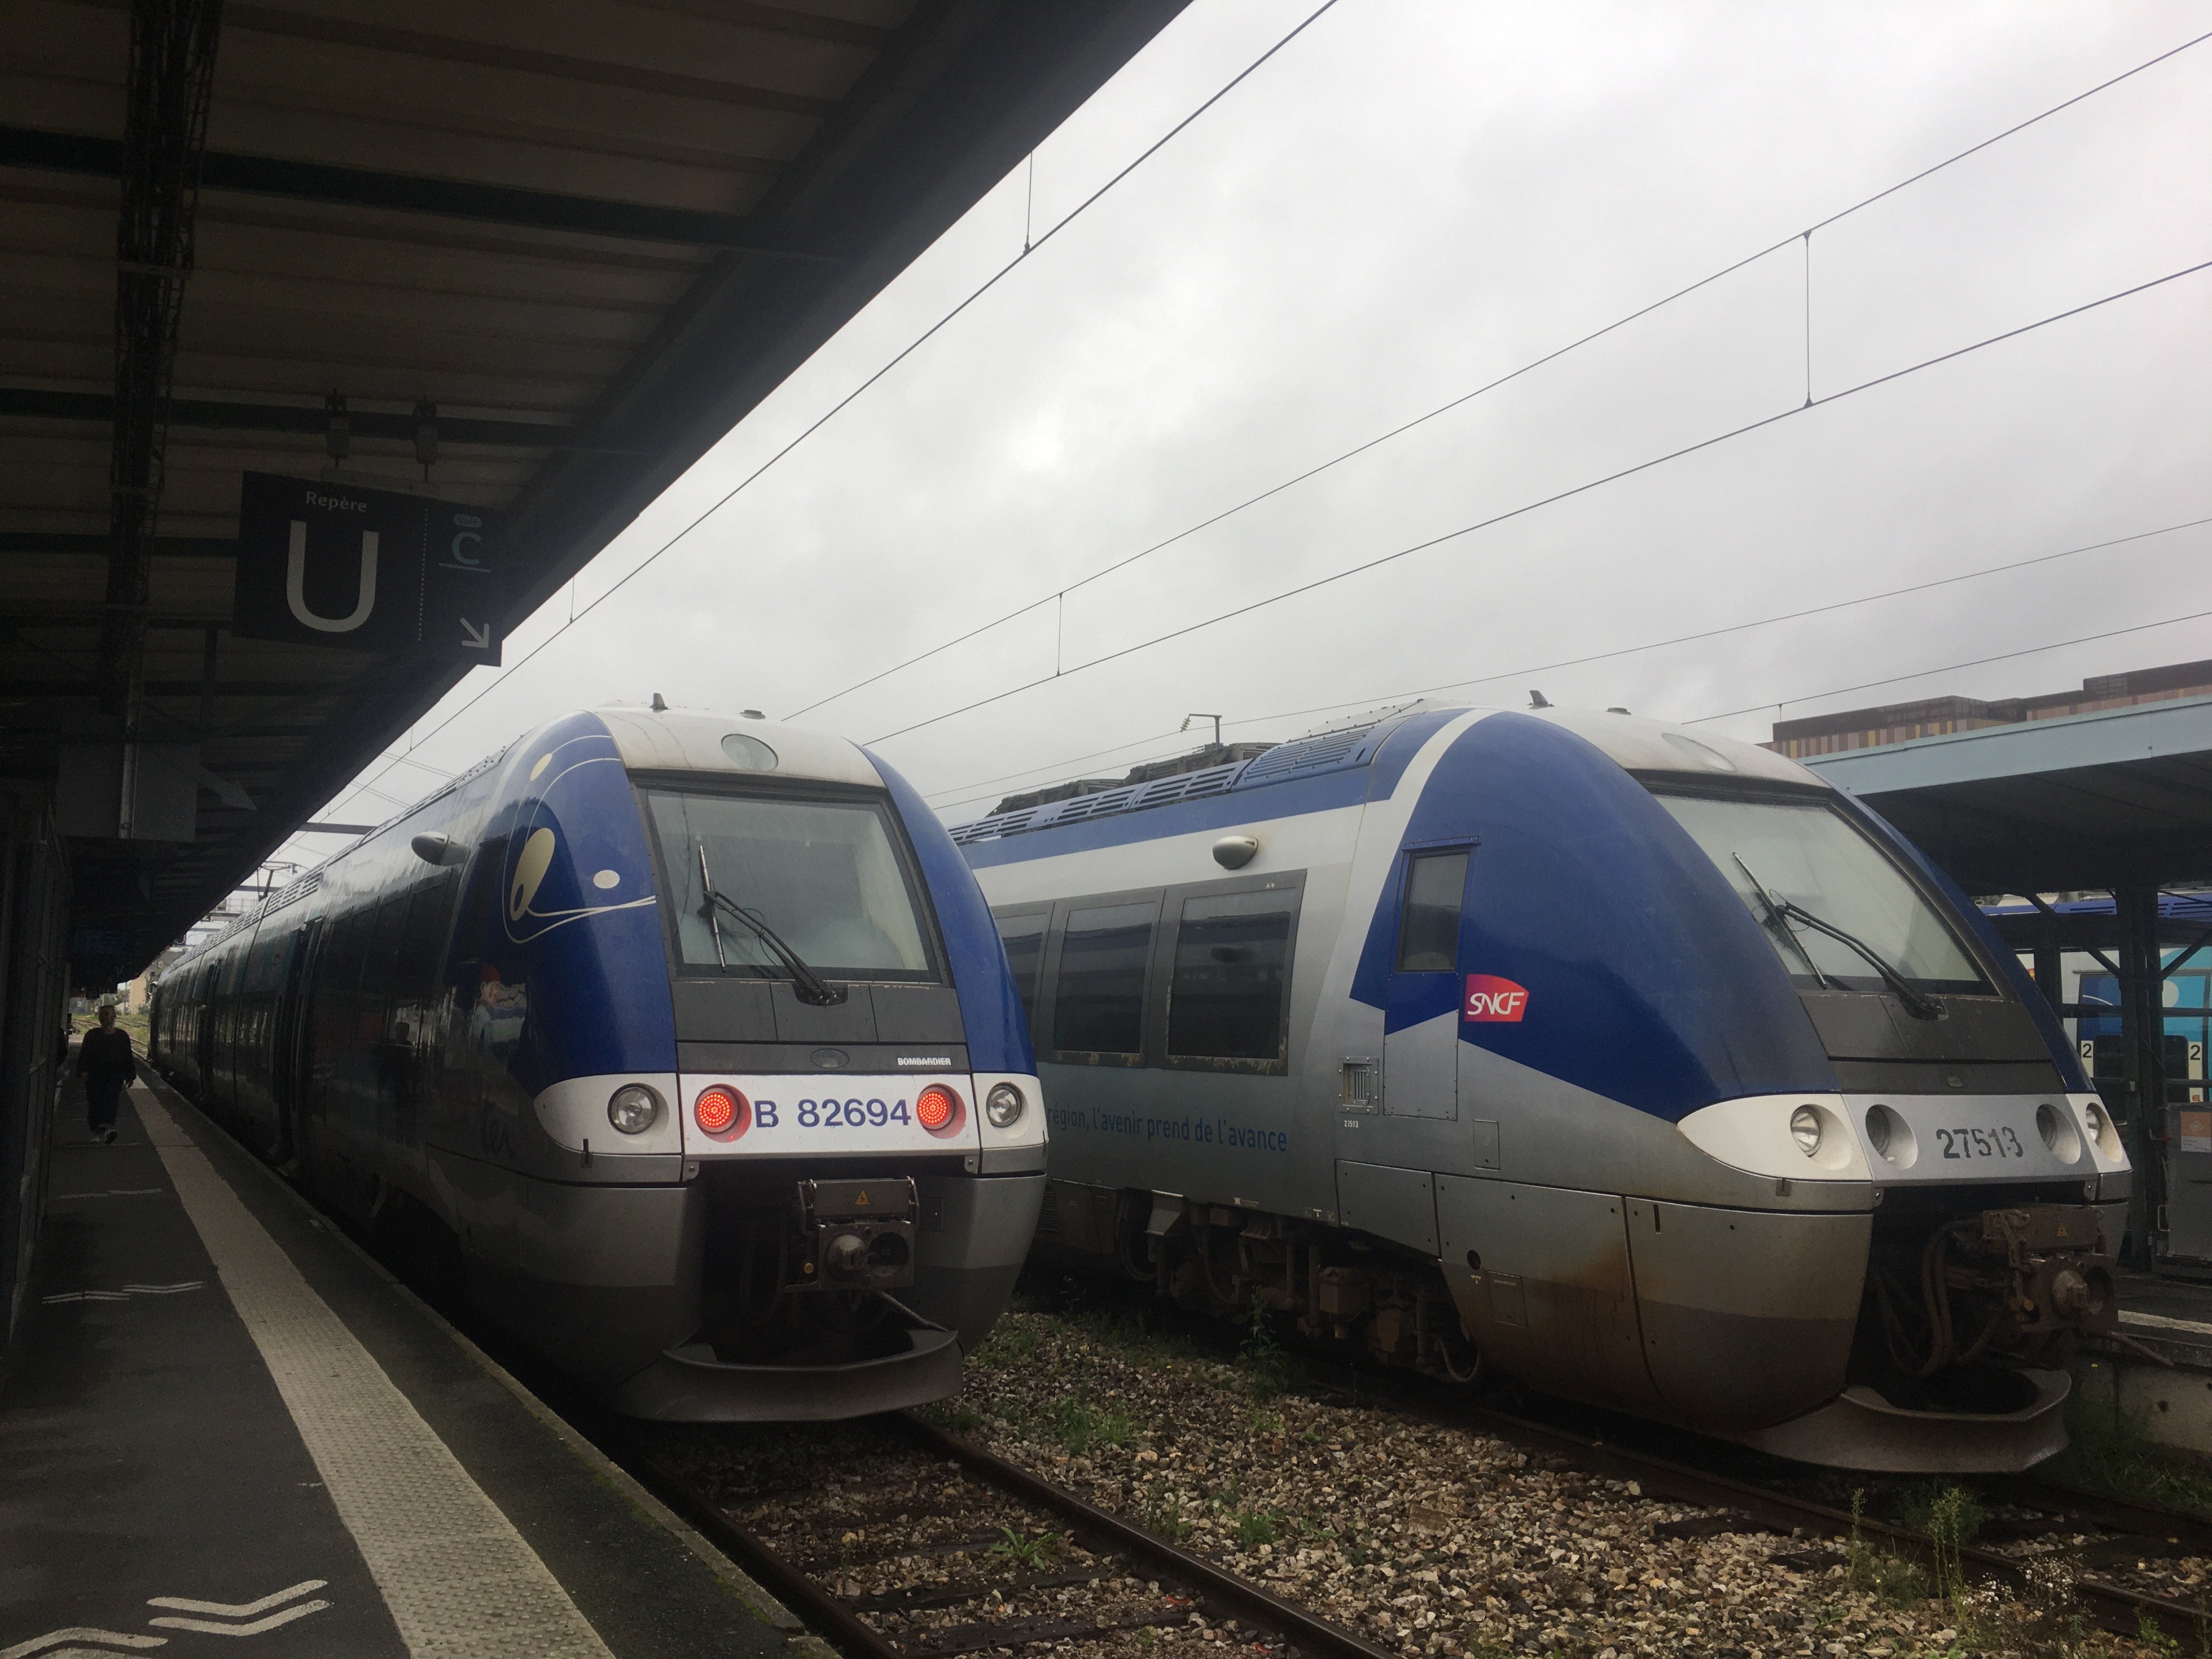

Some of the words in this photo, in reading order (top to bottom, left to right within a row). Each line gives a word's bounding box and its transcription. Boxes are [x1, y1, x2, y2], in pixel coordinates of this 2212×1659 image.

[306, 491, 366, 511] Repère
[452, 532, 482, 565] C
[286, 520, 379, 632] U
[1467, 992, 1525, 1015] SNCF
[2082, 1043, 2092, 1058] 2
[2190, 1045, 2200, 1060] 2
[754, 1100, 779, 1128] B
[798, 1098, 911, 1127] 82694
[1344, 1120, 1358, 1128] 27513
[1047, 1102, 1089, 1132] région,
[1093, 1106, 1143, 1135] l'avenir
[1147, 1115, 1189, 1142] prend
[1195, 1117, 1212, 1143] de
[1218, 1119, 1287, 1152] l'avance
[1936, 1126, 2023, 1159] 27513
